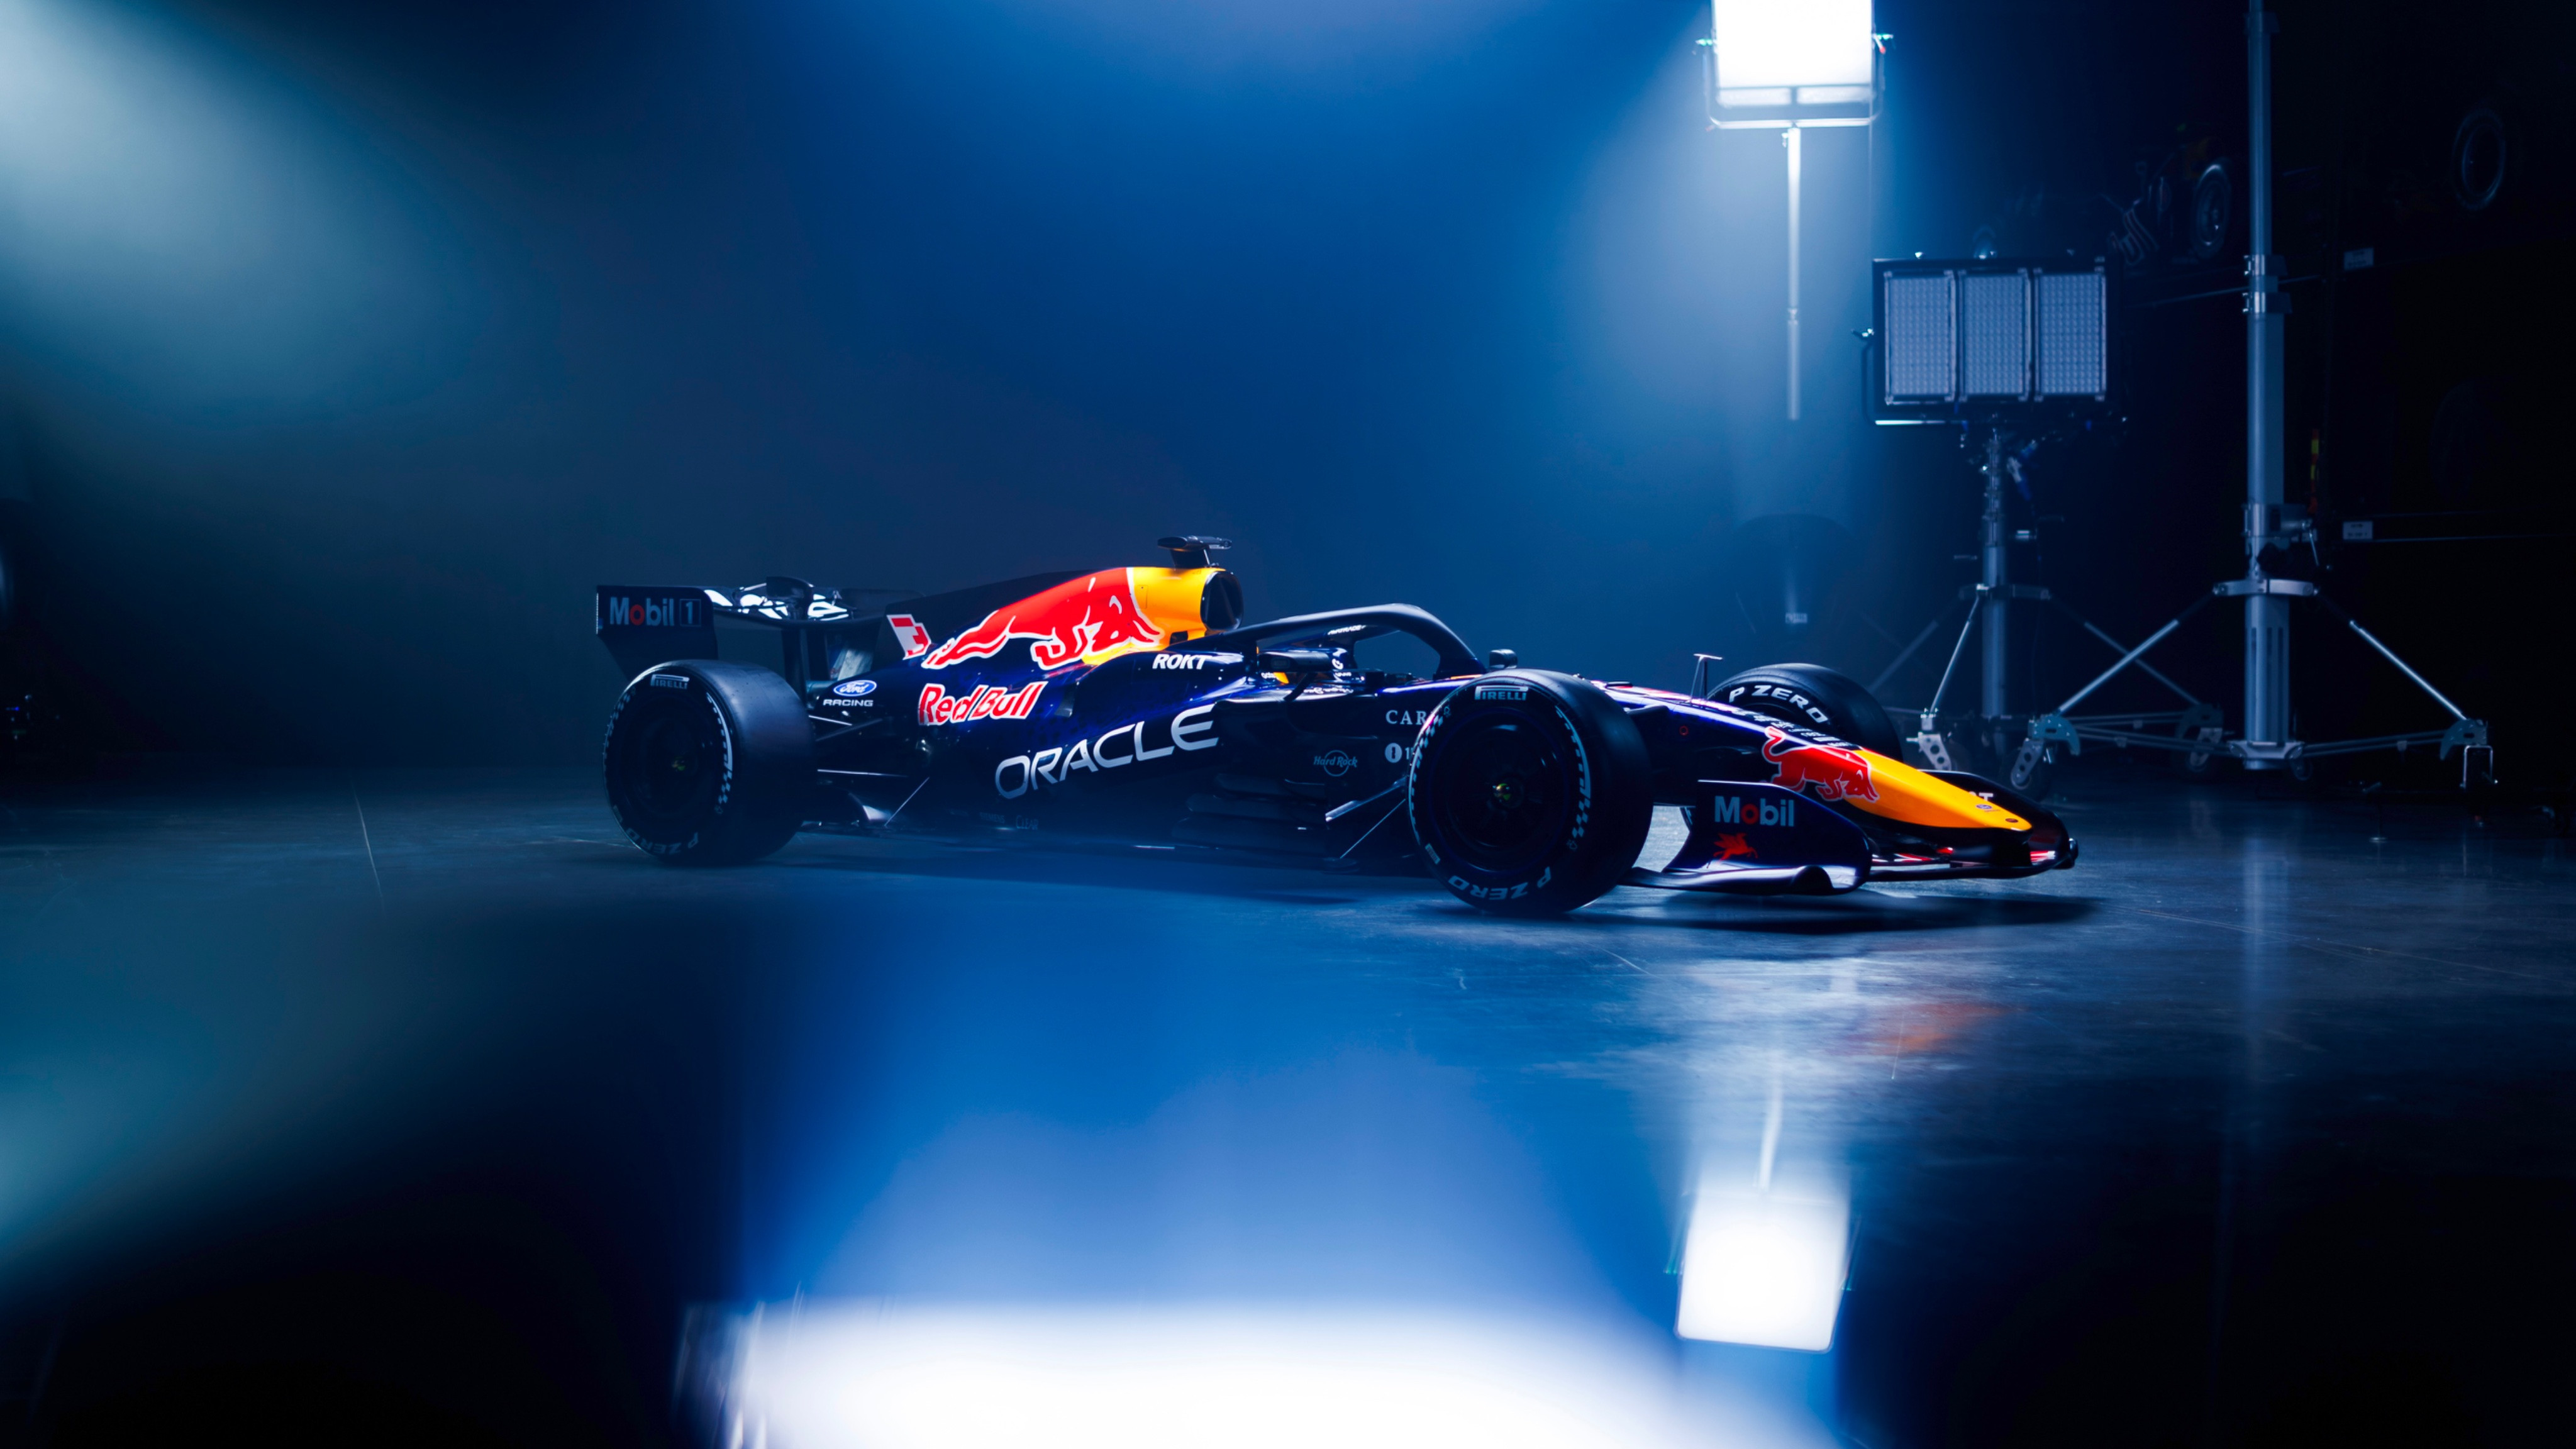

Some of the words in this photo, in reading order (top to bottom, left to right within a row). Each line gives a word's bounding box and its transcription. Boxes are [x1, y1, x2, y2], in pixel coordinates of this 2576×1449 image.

[610, 597, 674, 626] Mobil
[1152, 653, 1213, 670] ROKT
[650, 674, 690, 689] PIRELLI
[840, 681, 870, 694] Ford
[823, 699, 874, 708] RACING
[918, 682, 989, 726] Red
[967, 680, 1049, 721] Bull
[1474, 685, 1530, 701] PIRELLI
[1729, 686, 1745, 702] P
[1752, 685, 1828, 723] ZERO
[995, 702, 1219, 799] ORACLE
[1313, 755, 1336, 766] Hard
[1336, 756, 1358, 768] Rock
[1714, 795, 1795, 827] Mobil
[626, 828, 682, 855] ZERO
[688, 831, 699, 849] P
[1448, 875, 1529, 901] ZERO
[1536, 866, 1552, 888] P
